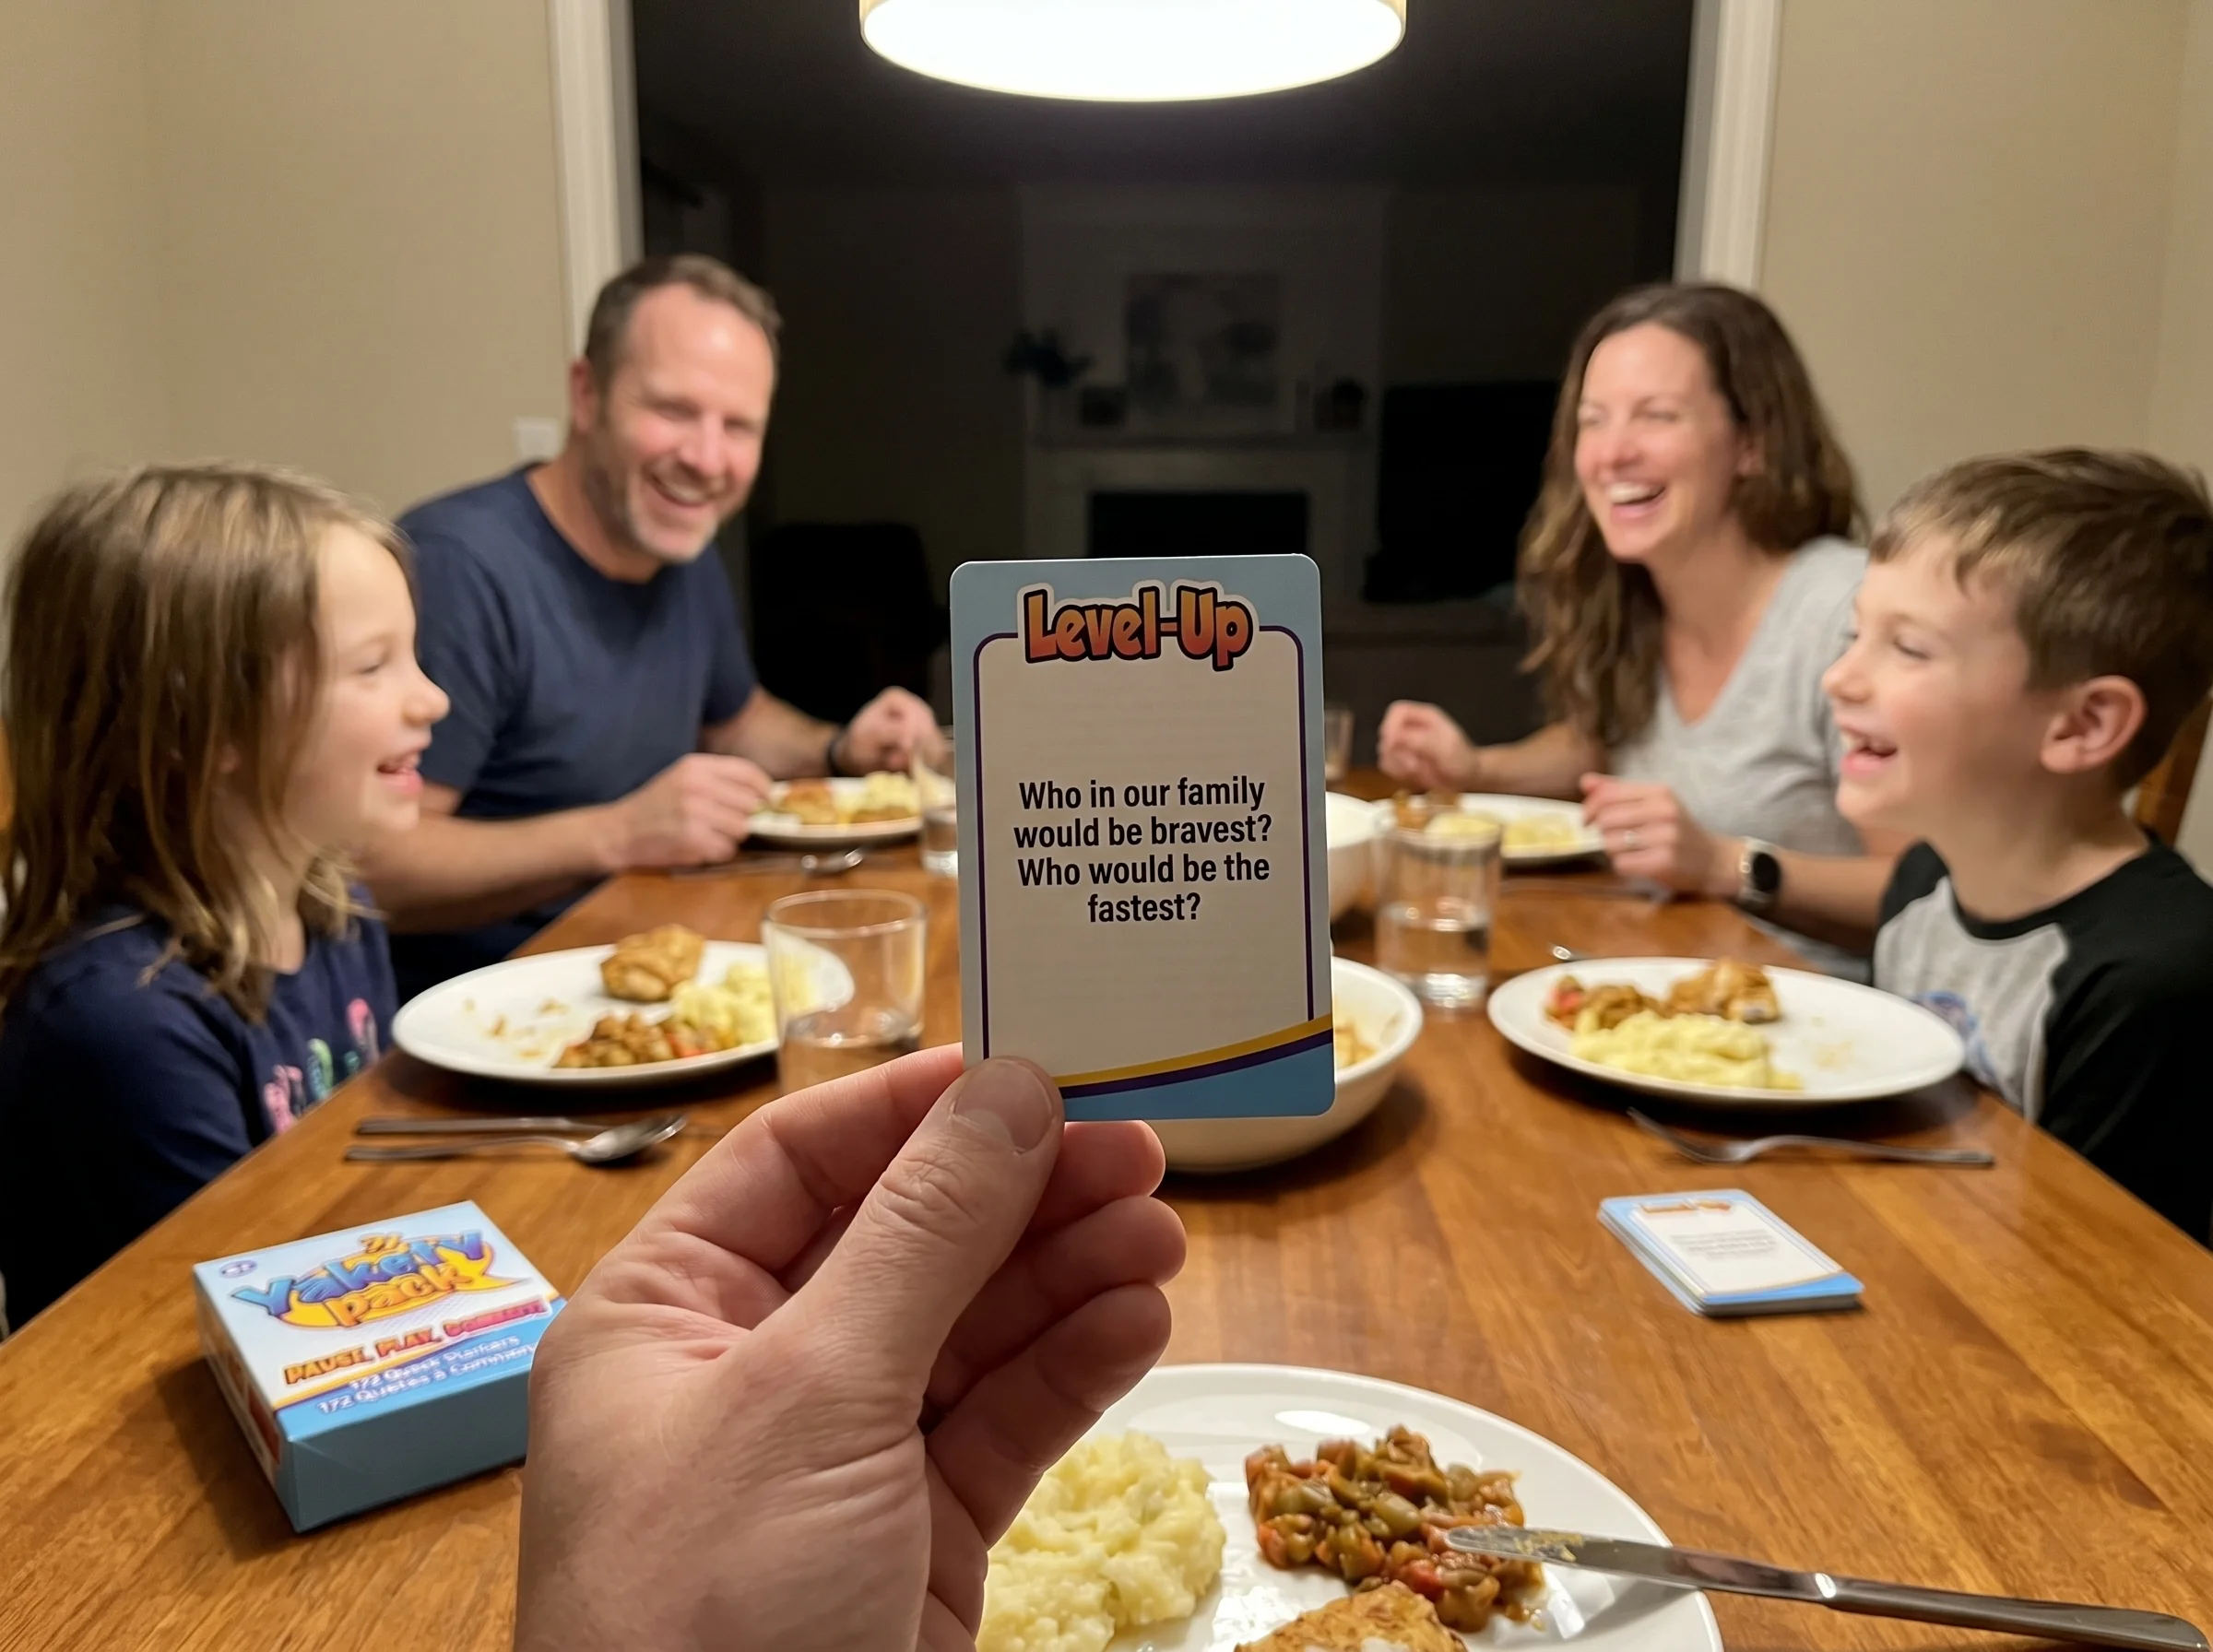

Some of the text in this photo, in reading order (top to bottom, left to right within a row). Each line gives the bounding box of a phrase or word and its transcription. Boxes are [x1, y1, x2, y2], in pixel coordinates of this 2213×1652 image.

[1024, 585, 1252, 671] Level-Up
[1019, 775, 1265, 811] Who in our family
[1013, 813, 1272, 848] would be bravest?
[1018, 852, 1270, 886] Who would be the
[1088, 892, 1201, 923] fastest?
